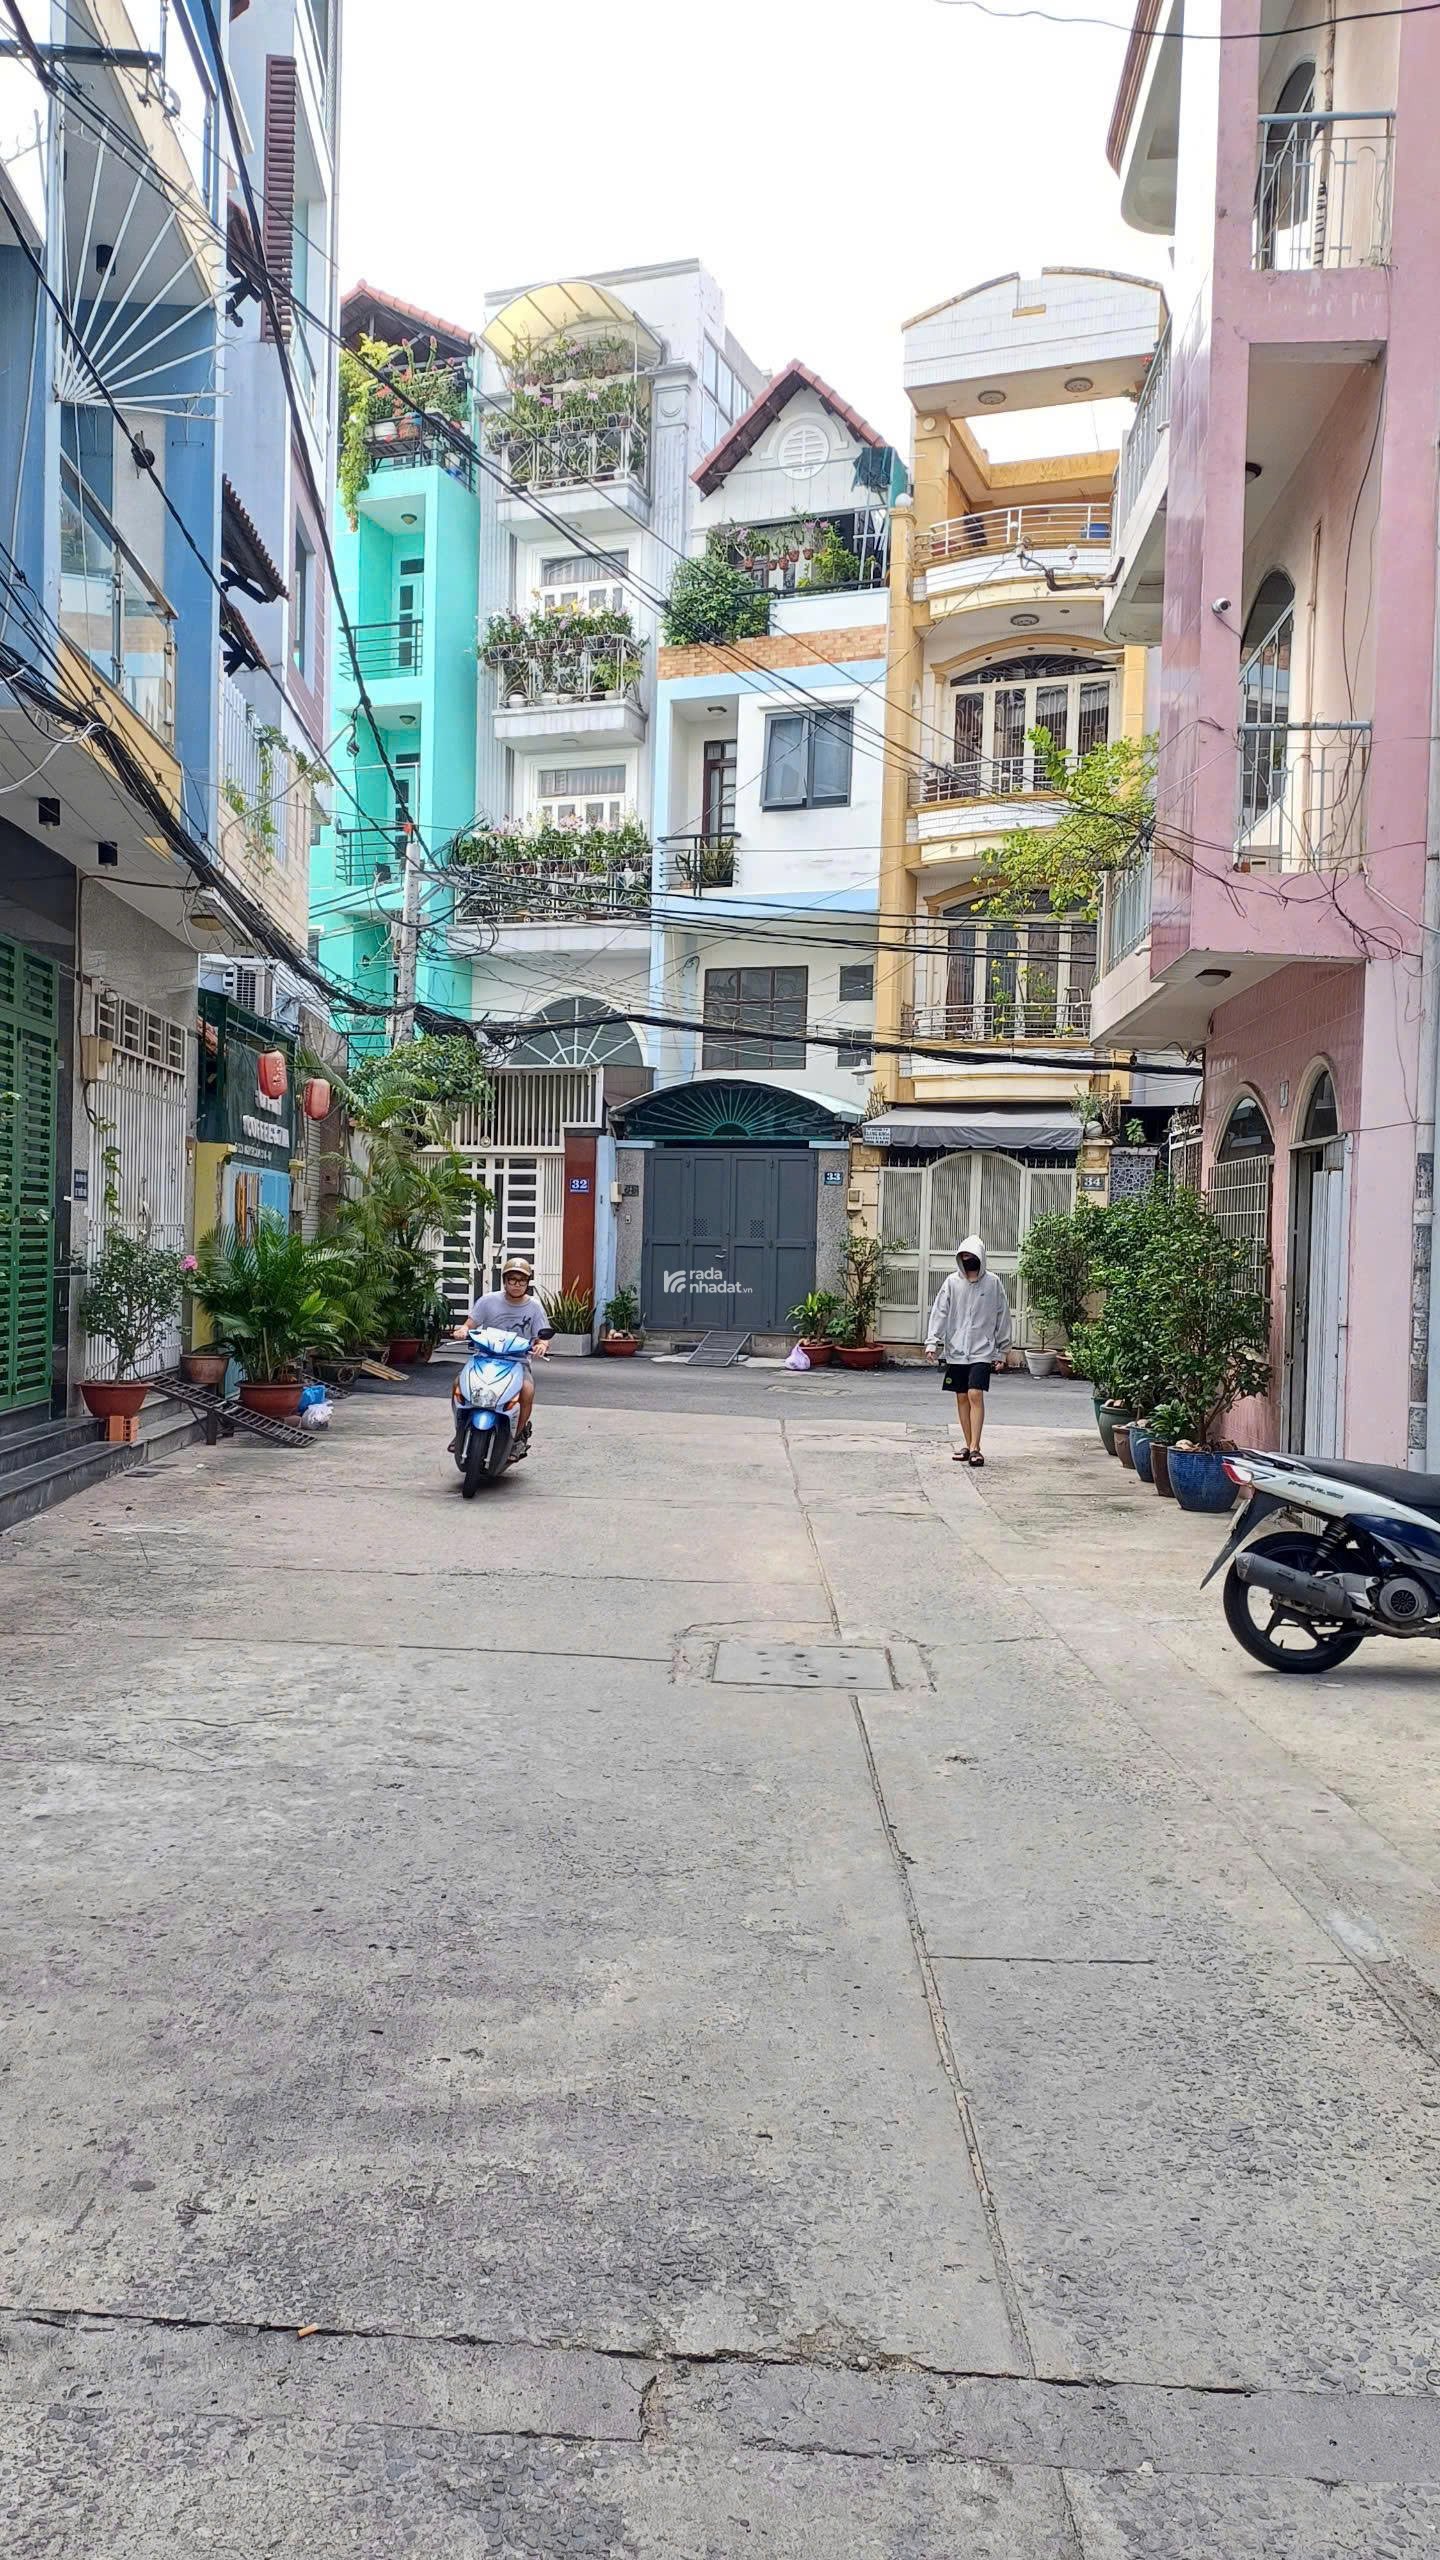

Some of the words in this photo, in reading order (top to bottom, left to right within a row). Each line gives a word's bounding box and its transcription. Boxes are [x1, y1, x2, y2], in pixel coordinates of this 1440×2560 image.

[826, 1172, 841, 1181] 33
[571, 1179, 588, 1189] 32
[1084, 1177, 1101, 1187] 34
